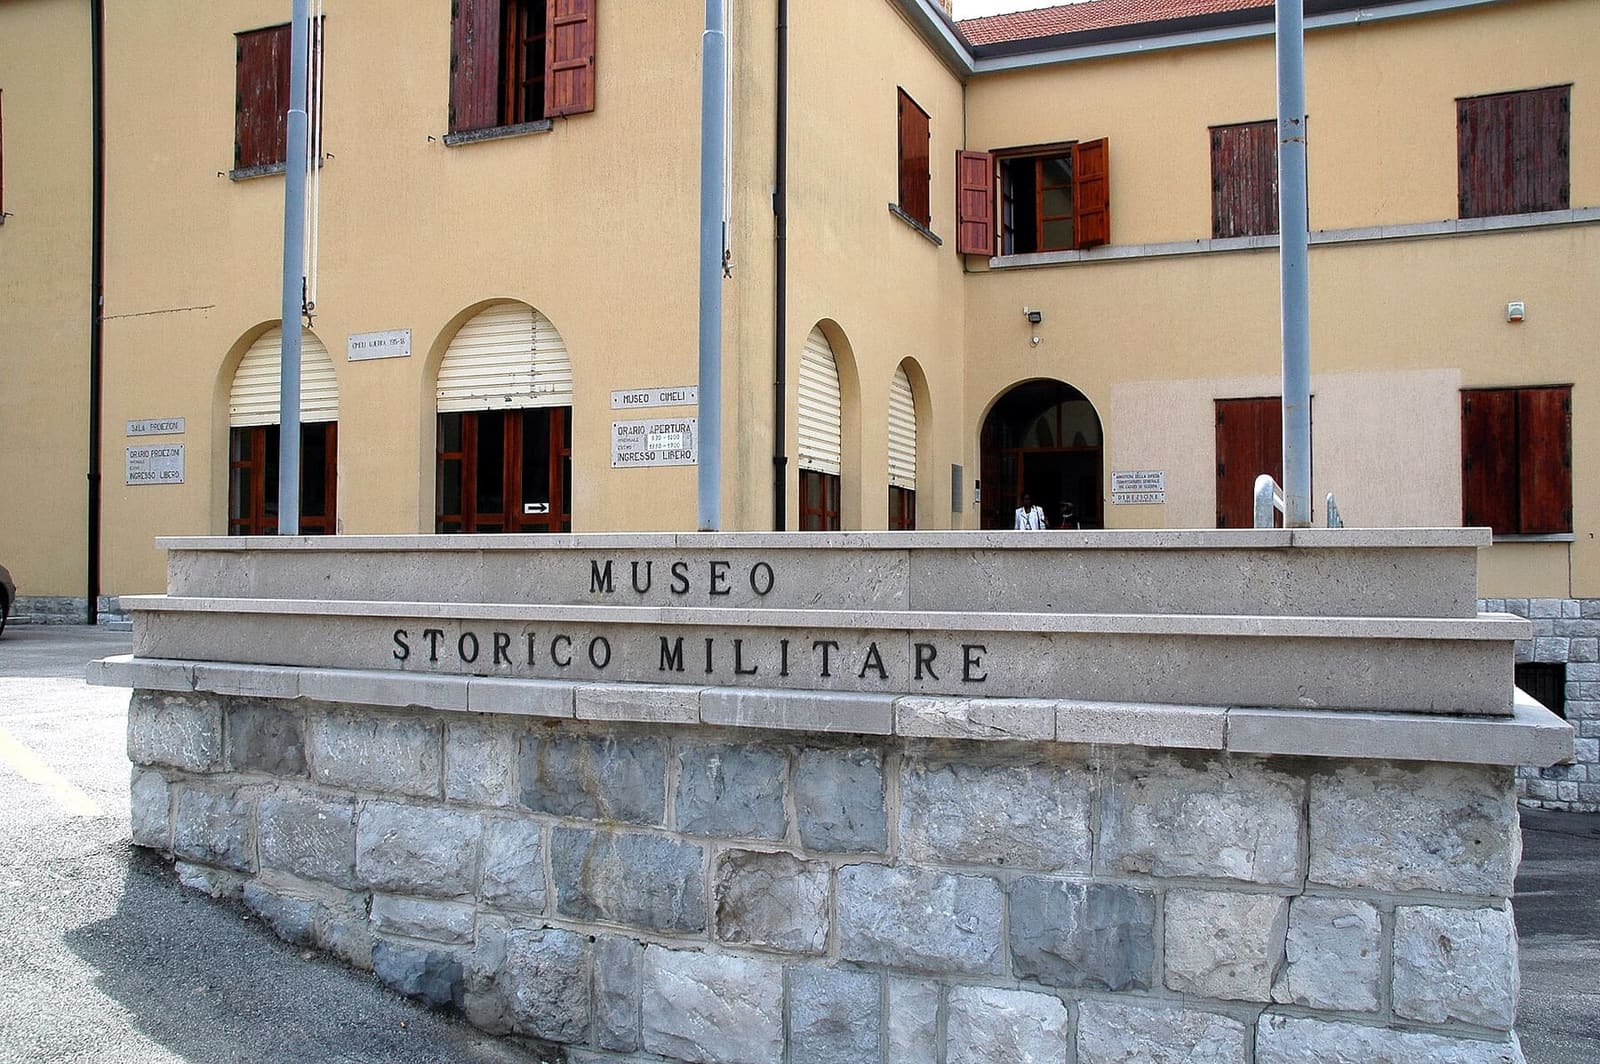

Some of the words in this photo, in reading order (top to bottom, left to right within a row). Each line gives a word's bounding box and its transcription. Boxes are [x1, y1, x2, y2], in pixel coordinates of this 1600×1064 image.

[623, 394, 650, 404] MUSEO
[660, 391, 685, 402] CIMELI
[617, 425, 646, 436] ORARIO
[649, 424, 691, 434] APERTURA
[618, 451, 656, 462] INGRESSO
[662, 450, 692, 460] LIBERO
[130, 472, 156, 480] INGRESSO
[160, 470, 180, 479] LIBERO
[589, 560, 775, 596] MUSEO
[393, 629, 611, 669] STORICO
[658, 636, 988, 682] MILITARE
